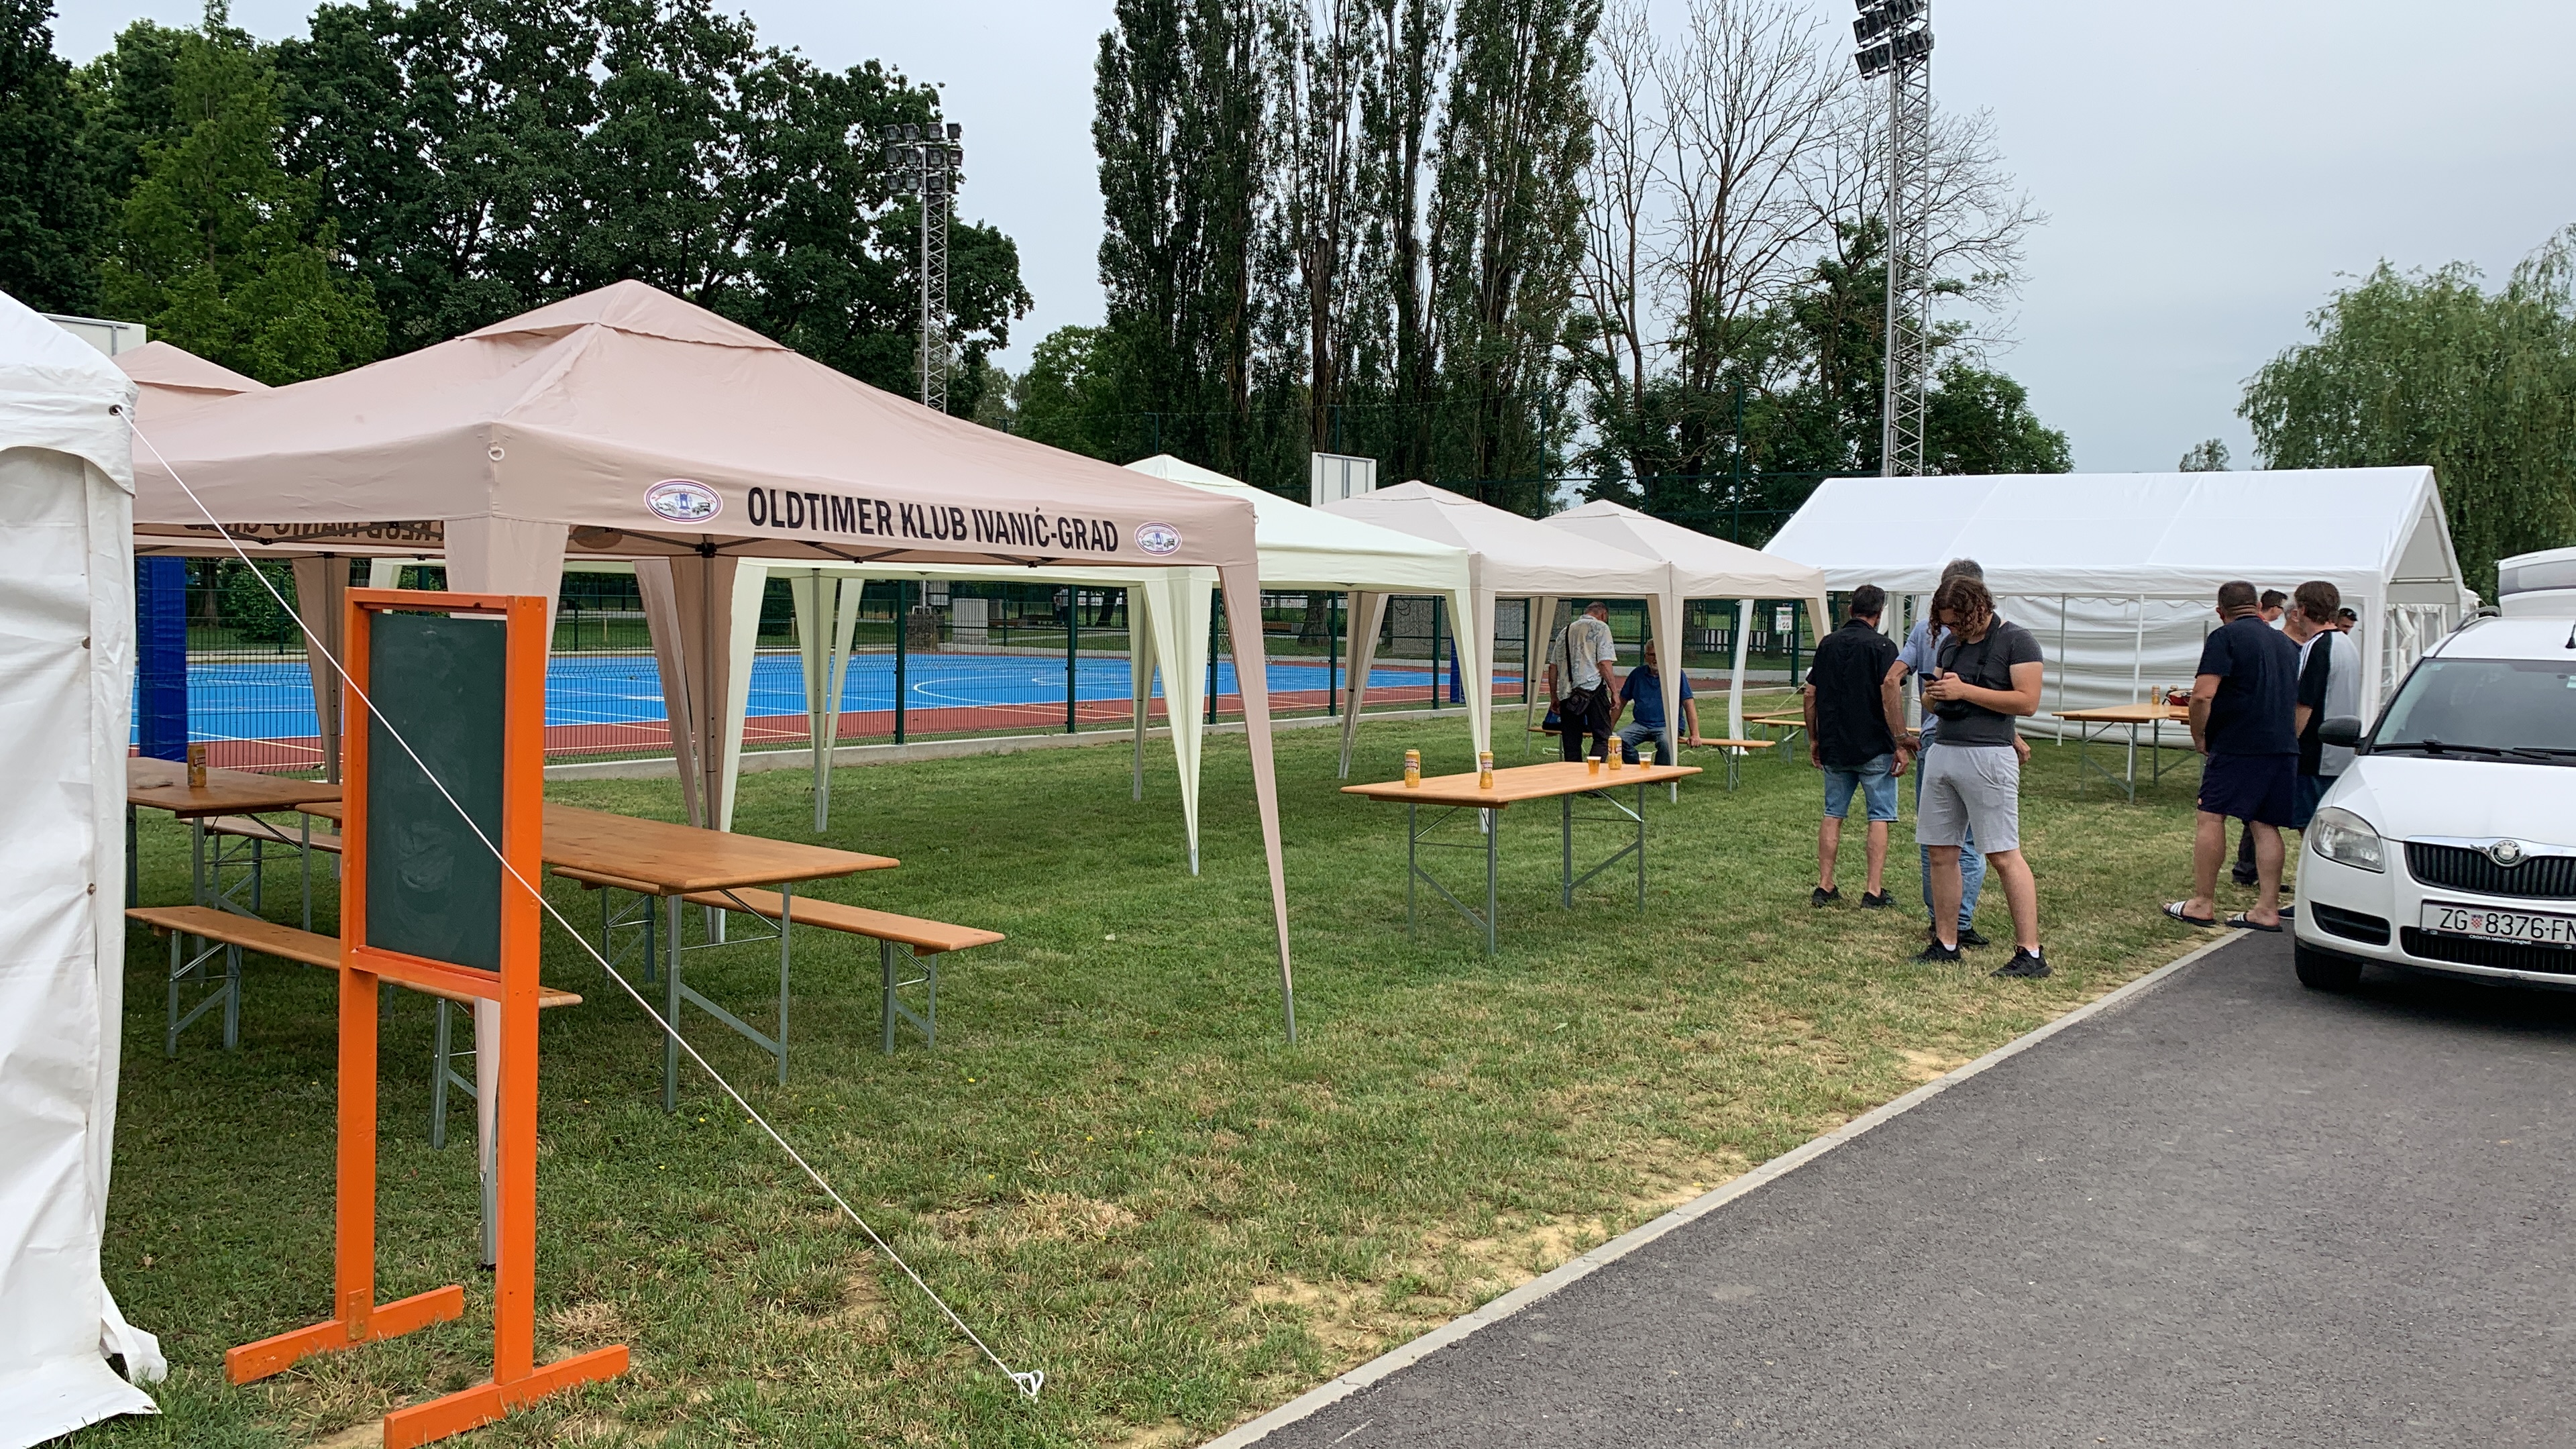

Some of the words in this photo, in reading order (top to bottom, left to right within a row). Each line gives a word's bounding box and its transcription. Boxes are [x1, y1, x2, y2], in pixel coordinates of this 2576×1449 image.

[748, 487, 895, 537] OLDTIMER
[899, 502, 967, 541] KLUB
[971, 506, 1118, 552] IVANIĆ-GRAD
[2440, 908, 2468, 930] ZG
